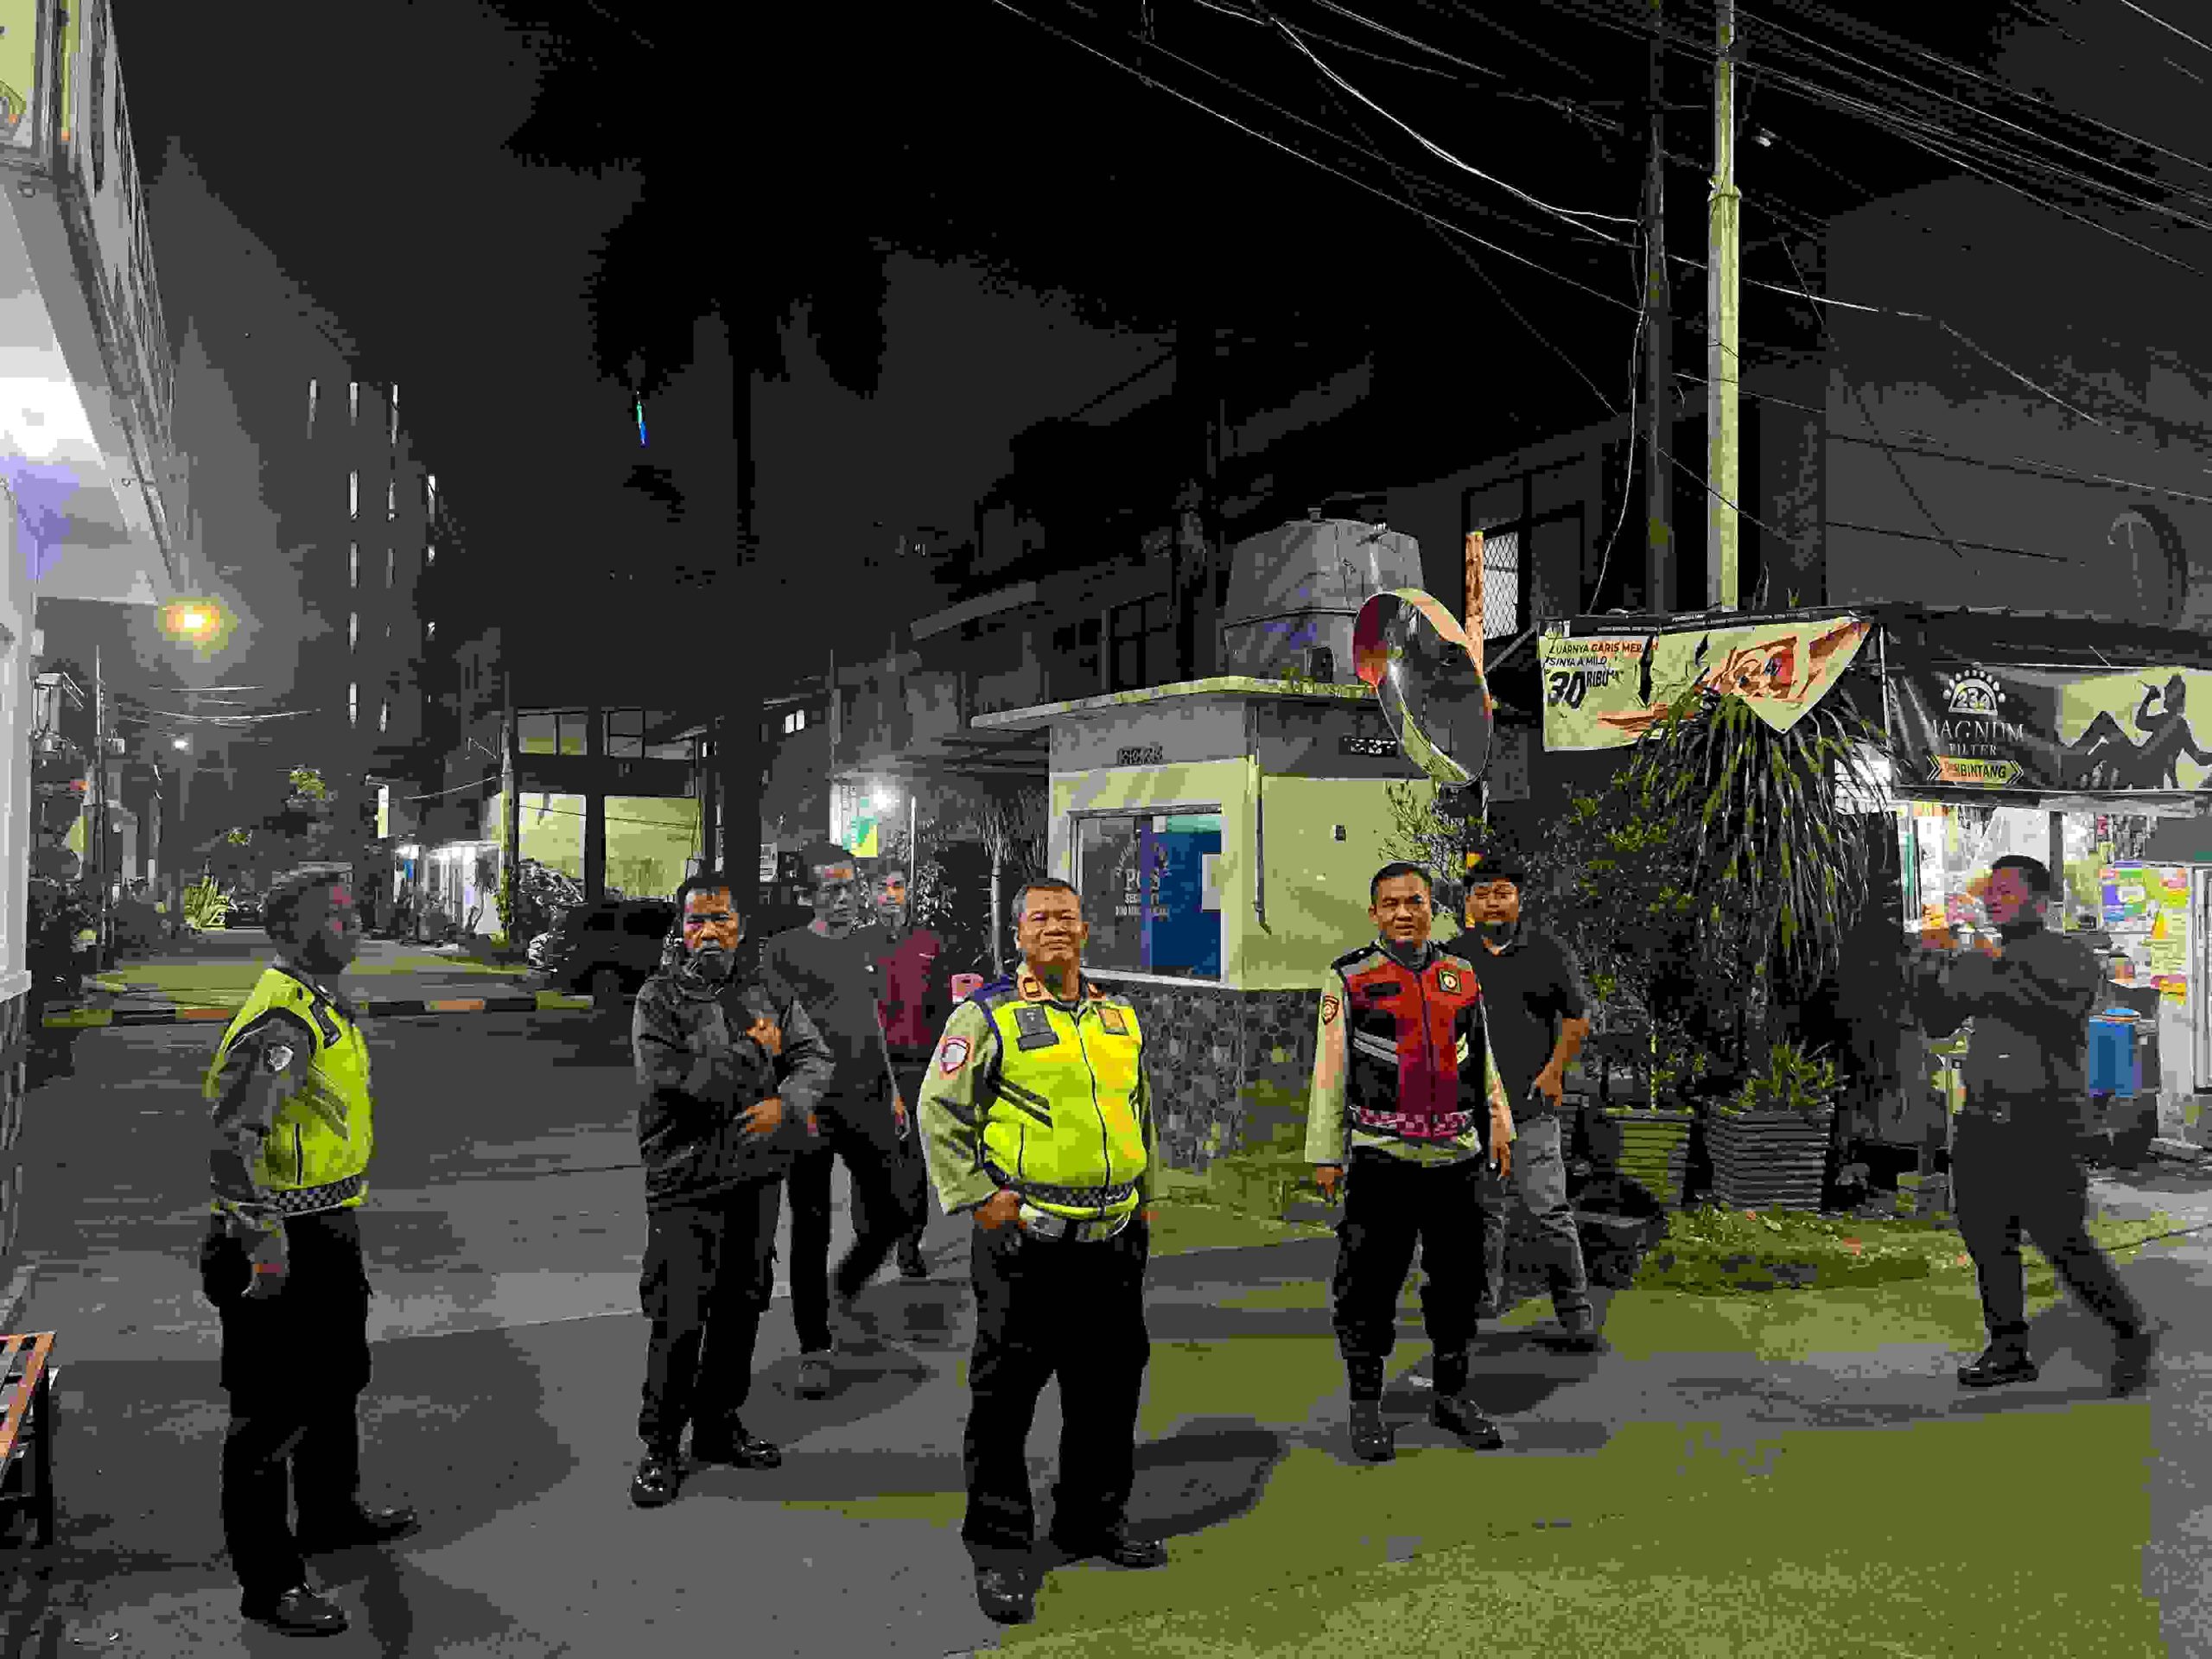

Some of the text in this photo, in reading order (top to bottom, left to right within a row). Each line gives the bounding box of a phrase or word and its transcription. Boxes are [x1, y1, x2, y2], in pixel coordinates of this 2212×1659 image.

[1591, 642, 1619, 652] GARIS
[1622, 640, 1658, 653] MERH
[1586, 655, 1607, 665] MILD
[1548, 671, 1586, 709] 30
[1957, 688, 1992, 709] 234
[1948, 743, 1997, 756] FILTER
[1960, 763, 2006, 779] BINTANG
